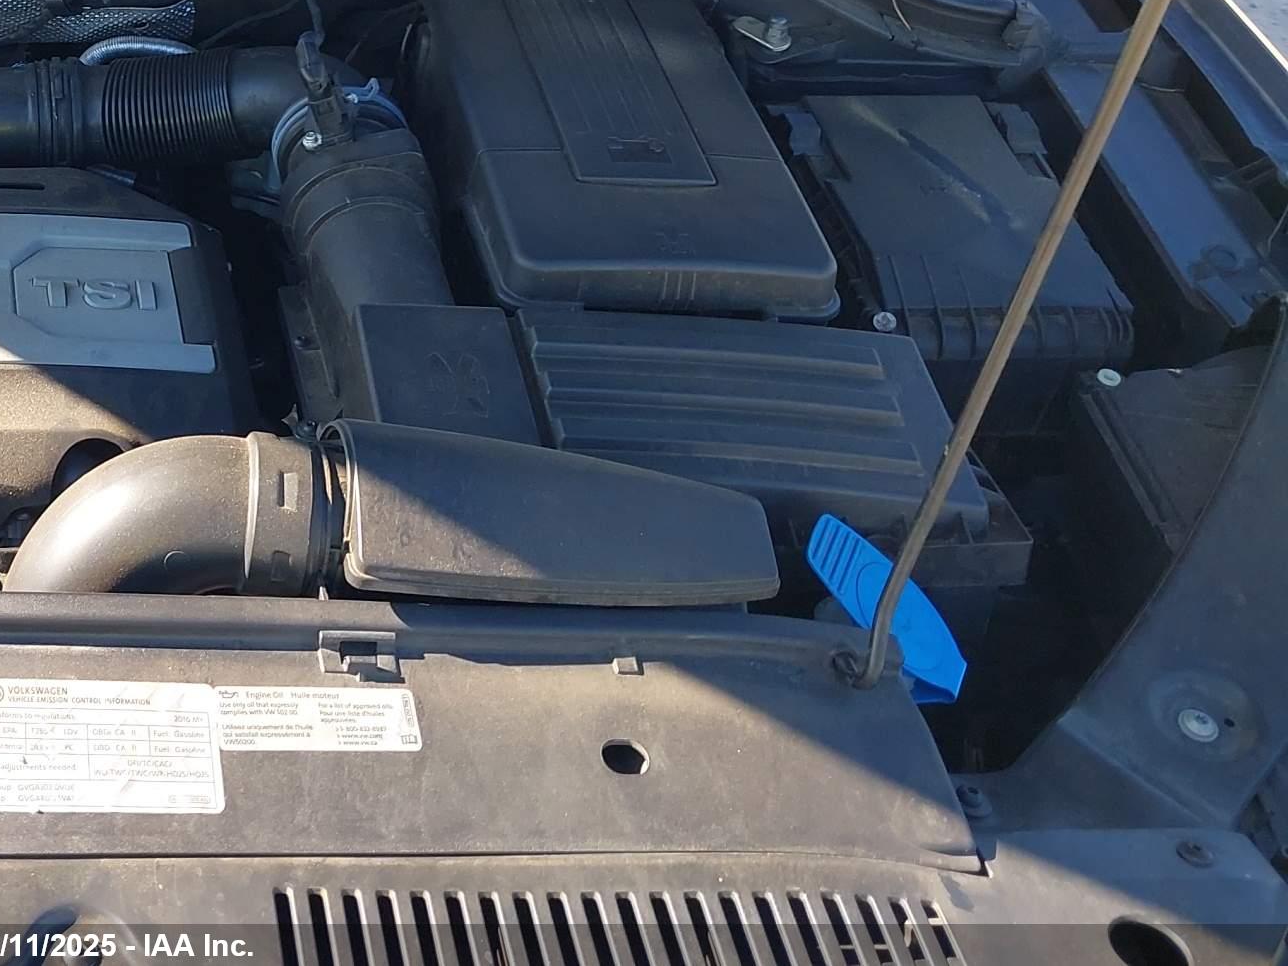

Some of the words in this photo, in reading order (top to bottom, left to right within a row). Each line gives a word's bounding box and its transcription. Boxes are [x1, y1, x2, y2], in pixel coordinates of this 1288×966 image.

[31, 276, 158, 311] TSI
[7, 685, 68, 695] VOLKSWAGEN
[7, 695, 35, 703] VEHICLE
[36, 696, 69, 704] EMISSION
[71, 697, 102, 705] CONTROL
[104, 698, 151, 706] INFORMATION
[245, 691, 271, 700] Engine
[312, 692, 340, 700] moteur
